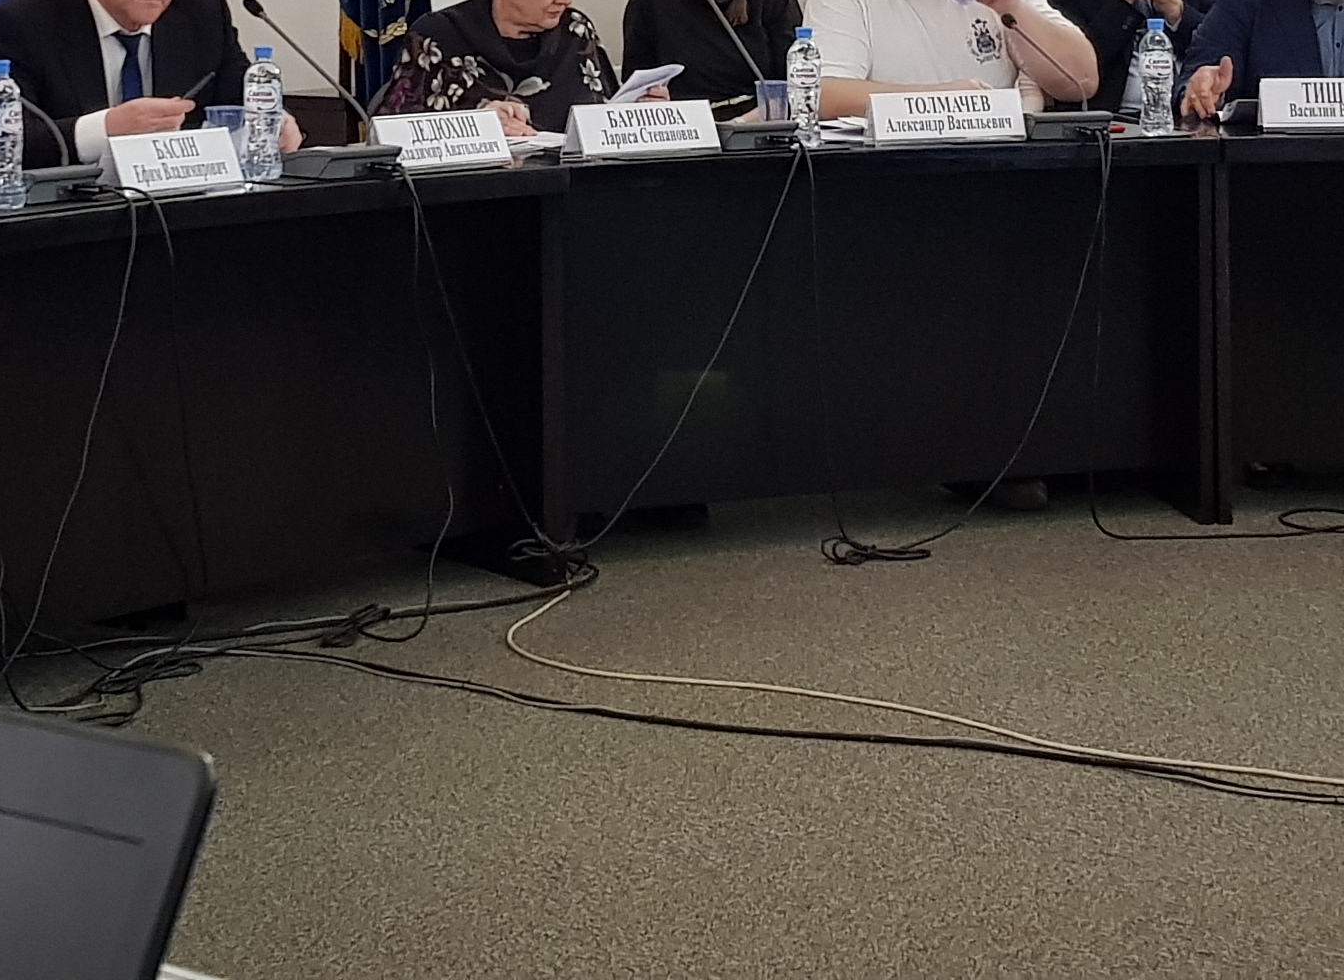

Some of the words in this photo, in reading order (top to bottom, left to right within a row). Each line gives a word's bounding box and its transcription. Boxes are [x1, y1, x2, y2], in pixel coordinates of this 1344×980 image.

[904, 95, 991, 115] ТОЛМАЧЕВ
[1289, 103, 1336, 118] Василий
[606, 107, 687, 129] БАРИНОВА
[886, 117, 945, 135] Александр
[946, 115, 1013, 131] Васильевич
[408, 116, 481, 146] ДЕДЮХИН
[601, 129, 638, 149] Лариса
[639, 127, 700, 144] Степановна
[152, 136, 200, 160] БАСИН
[444, 141, 501, 158] Анатольевич
[133, 163, 163, 187] Ефим
[161, 161, 229, 181] Владимирович
